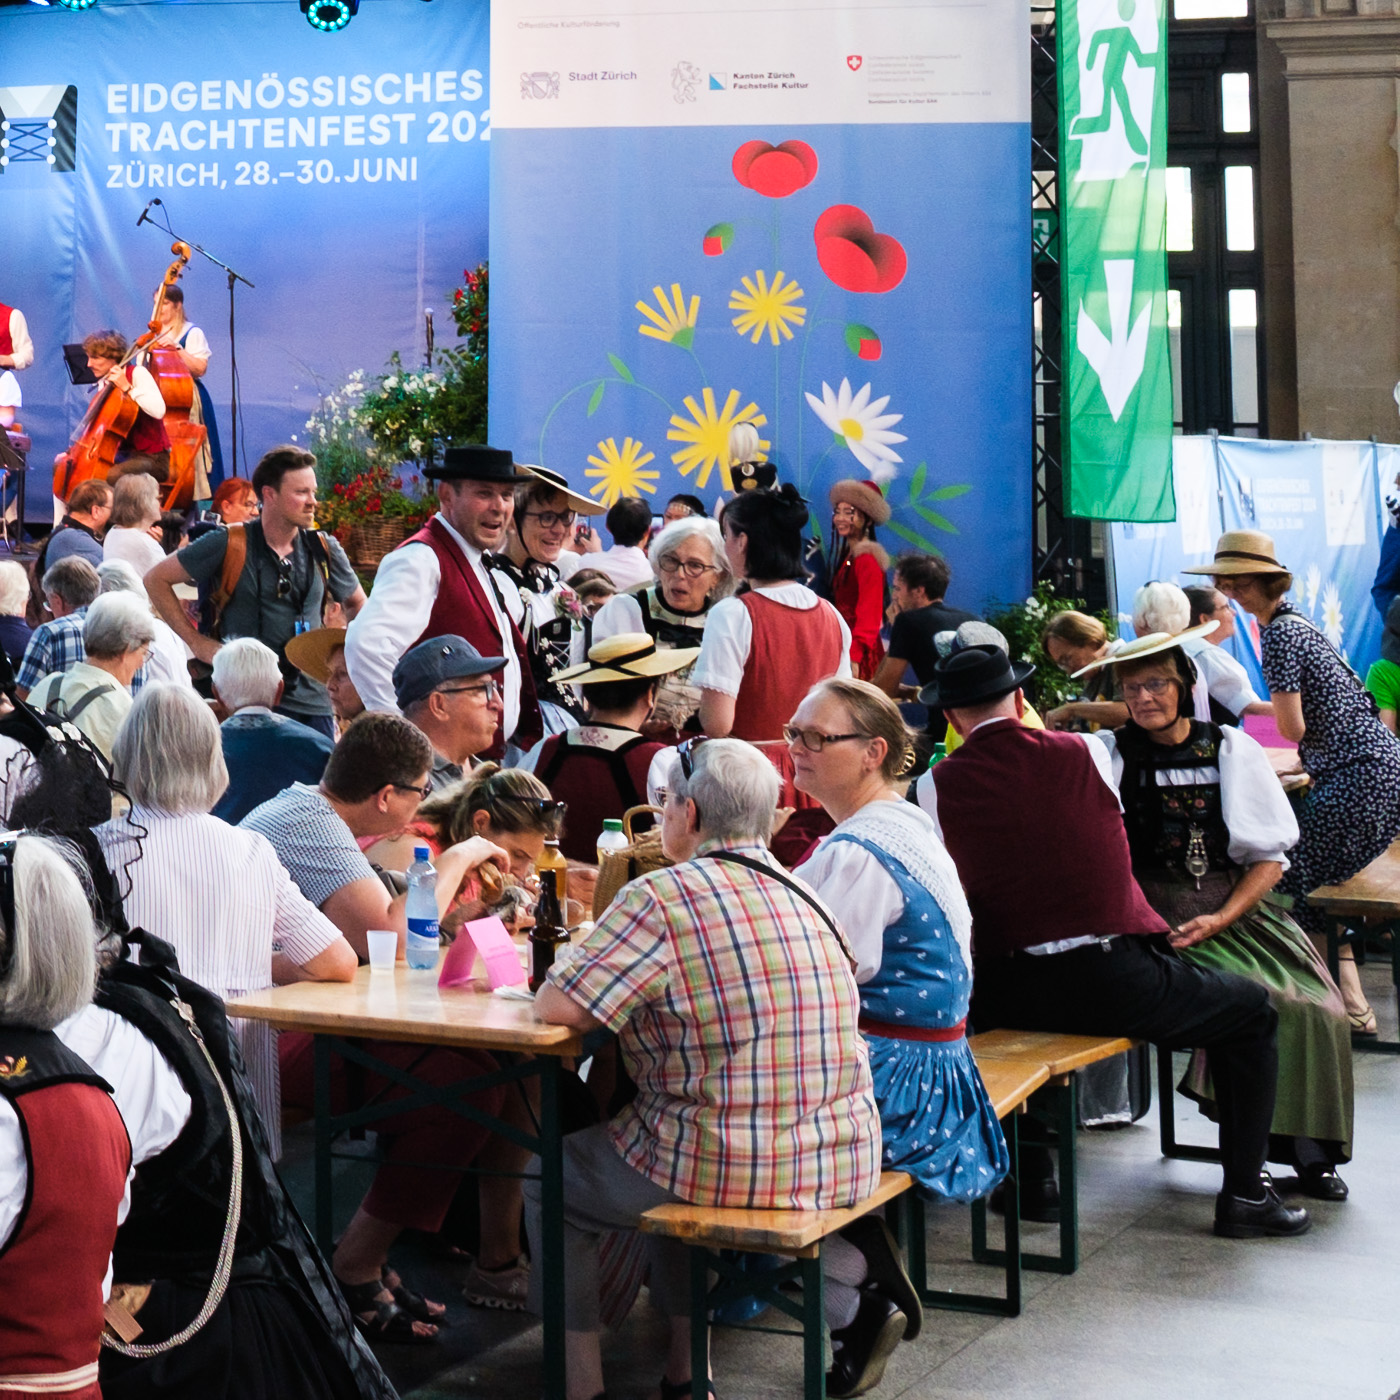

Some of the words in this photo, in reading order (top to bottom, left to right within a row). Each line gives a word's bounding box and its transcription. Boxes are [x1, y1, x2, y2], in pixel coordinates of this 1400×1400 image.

[568, 71, 598, 82] Stadt
[600, 70, 637, 81] Zürich
[733, 72, 765, 80] Kanton
[767, 71, 796, 80] Zürich
[733, 81, 779, 90] Fachstelle
[781, 81, 809, 90] Kultur
[107, 68, 484, 114] EIDGENÖSSISCHES
[105, 113, 417, 153] TRACHTENFEST
[106, 159, 228, 190] ZÜRICH,
